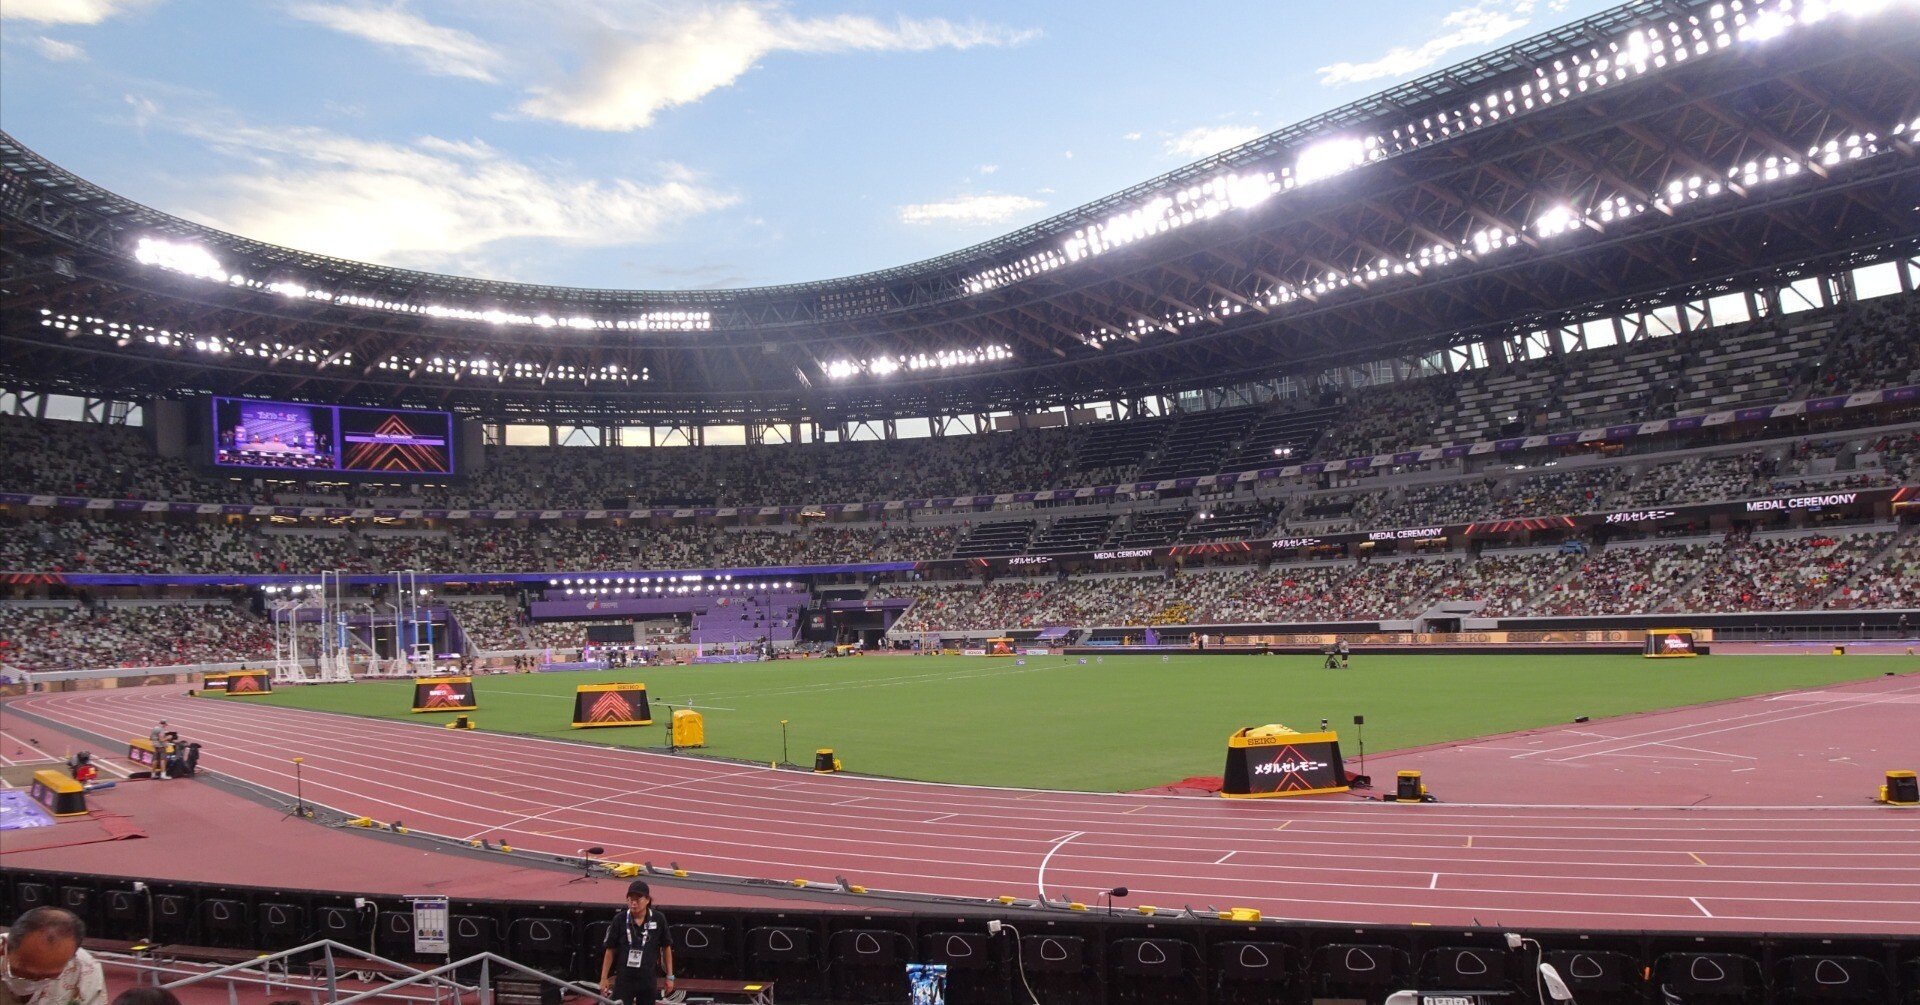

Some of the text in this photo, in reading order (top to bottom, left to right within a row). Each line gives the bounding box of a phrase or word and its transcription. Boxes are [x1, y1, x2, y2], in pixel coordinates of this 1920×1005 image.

[1746, 493, 1857, 512] MEDAL CEREMONY
[1605, 510, 1675, 524] メダルセレモニー
[1369, 527, 1443, 541] MEDAL CEREMONY
[1271, 538, 1321, 548] メダルセレモニー
[1093, 549, 1153, 560] MEDAL CEREMONY
[1008, 556, 1053, 565] メダルセレモニー
[1287, 634, 1321, 643] SEIKO
[1445, 633, 1488, 643] SEIKO
[1247, 737, 1277, 746] SEIKO
[1254, 761, 1328, 775] メダルセレモニー
